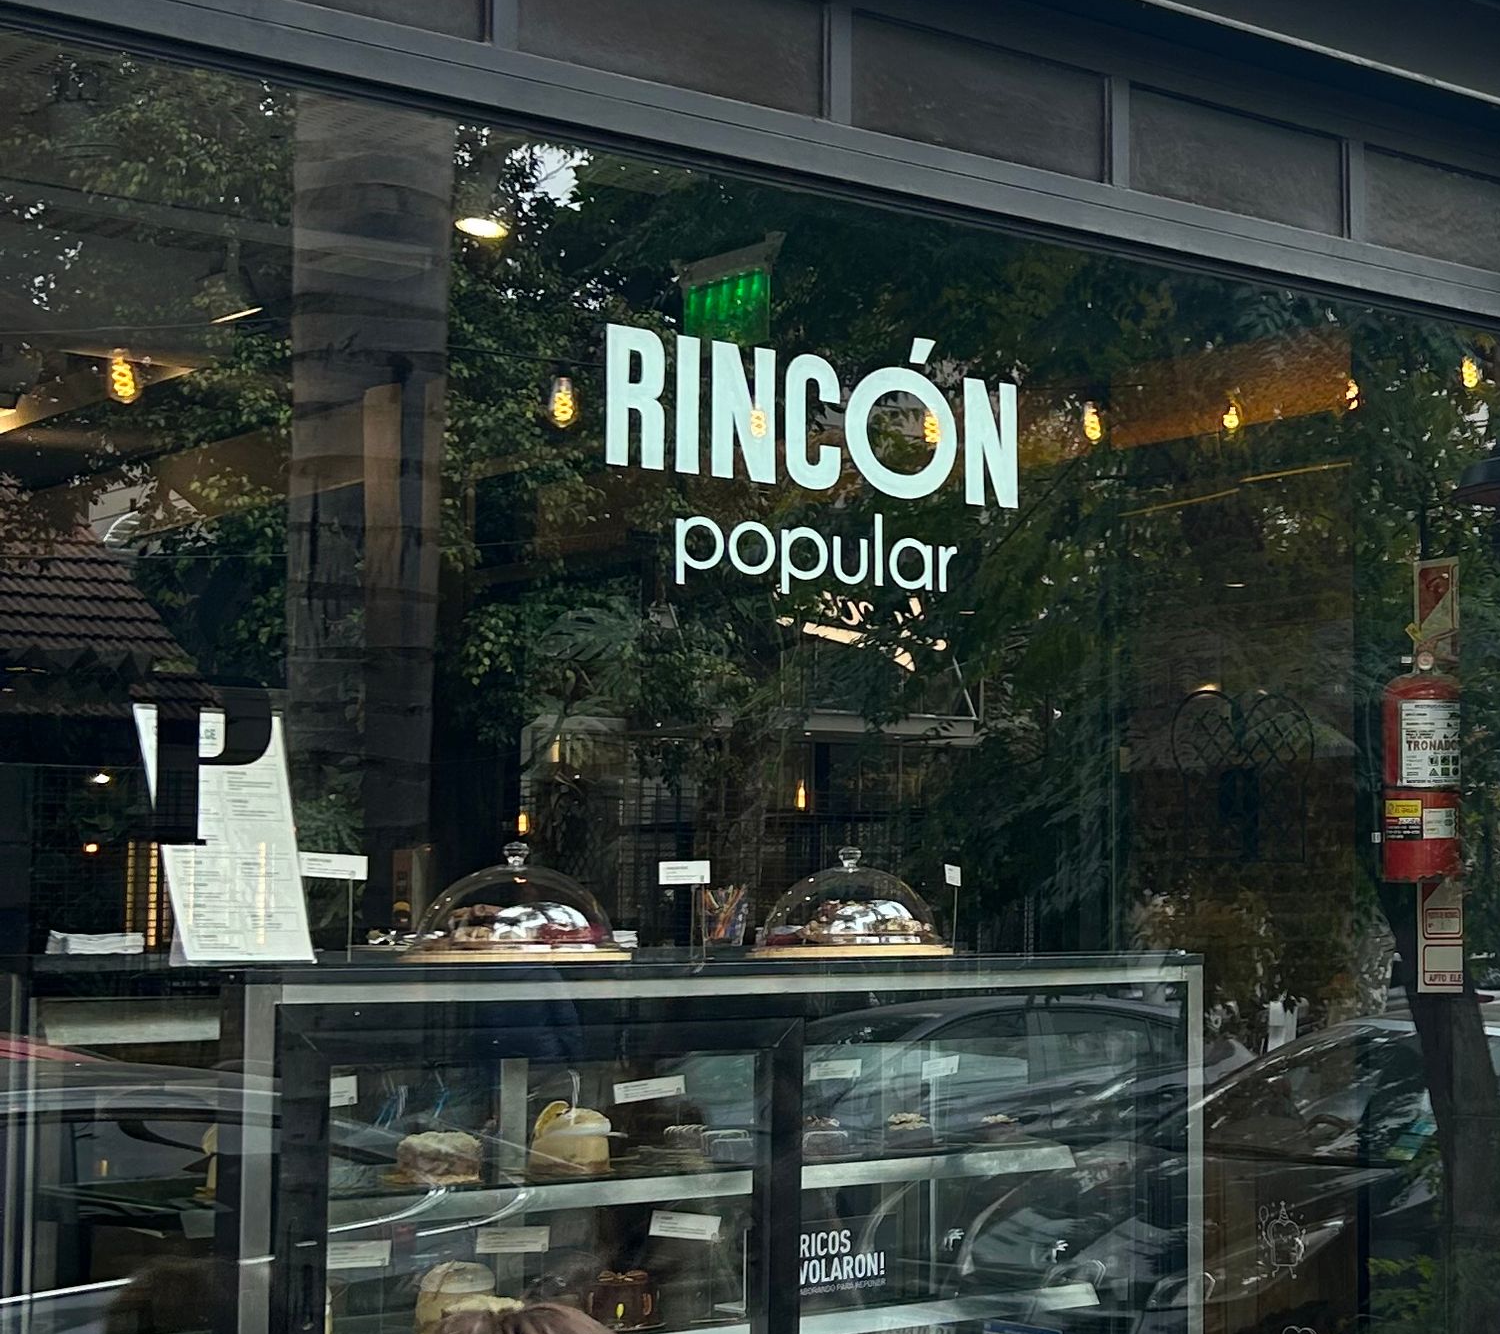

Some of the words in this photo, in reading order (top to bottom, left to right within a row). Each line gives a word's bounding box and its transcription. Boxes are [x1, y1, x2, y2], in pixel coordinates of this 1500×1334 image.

[605, 323, 1019, 509] RINCÓN
[675, 513, 958, 595] popular
[1406, 740, 1460, 752] TRONADO
[800, 1229, 851, 1258] RICOS
[799, 1251, 885, 1285] VOLARON!
